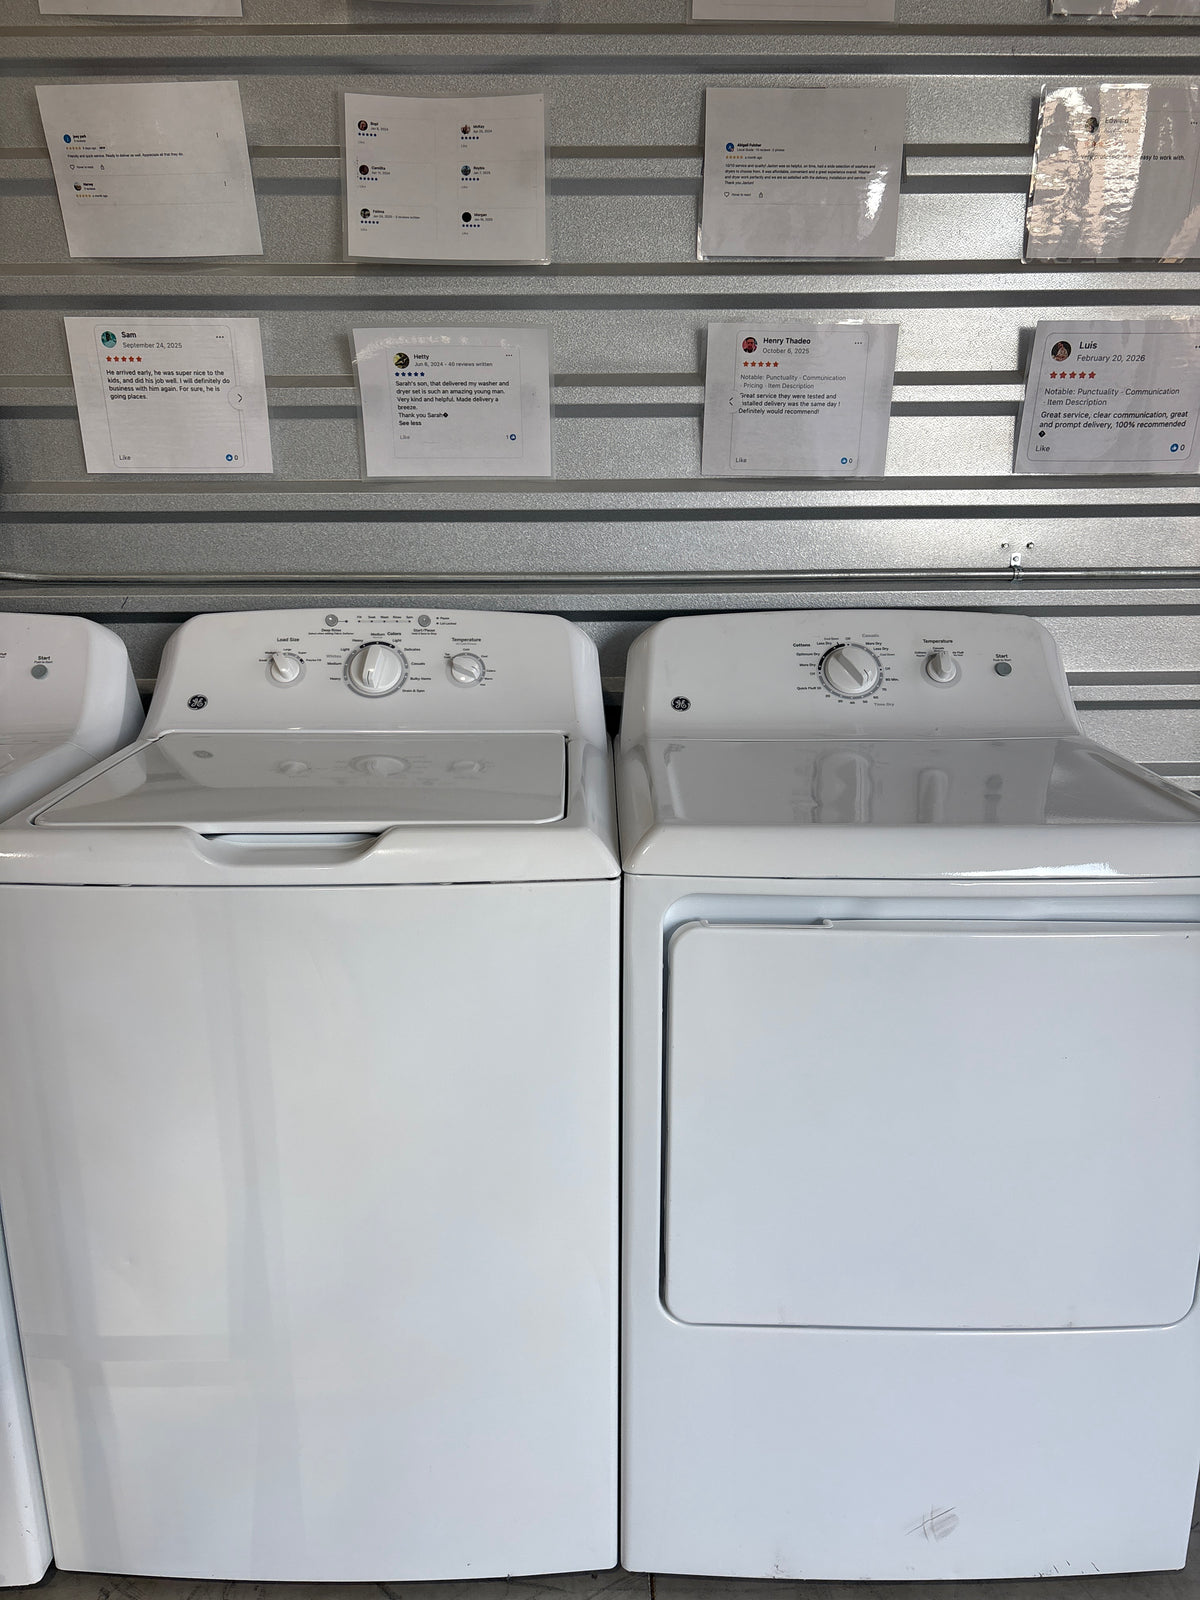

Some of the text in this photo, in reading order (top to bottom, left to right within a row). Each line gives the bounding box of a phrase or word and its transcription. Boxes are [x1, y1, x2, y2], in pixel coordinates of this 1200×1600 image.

[1080, 341, 1097, 349] Luis
[1077, 355, 1110, 363] February
[1112, 355, 1123, 363] 20,
[744, 382, 763, 390] Pricing
[1045, 387, 1075, 395] Notable:
[1077, 388, 1119, 397] Punctuality
[1065, 398, 1107, 407] Description
[1041, 411, 1061, 420] Great
[1063, 411, 1092, 419] service,
[1113, 411, 1168, 419] communication,
[1170, 411, 1188, 421] great
[1083, 421, 1112, 429] delivery,
[1137, 420, 1186, 428] recommended
